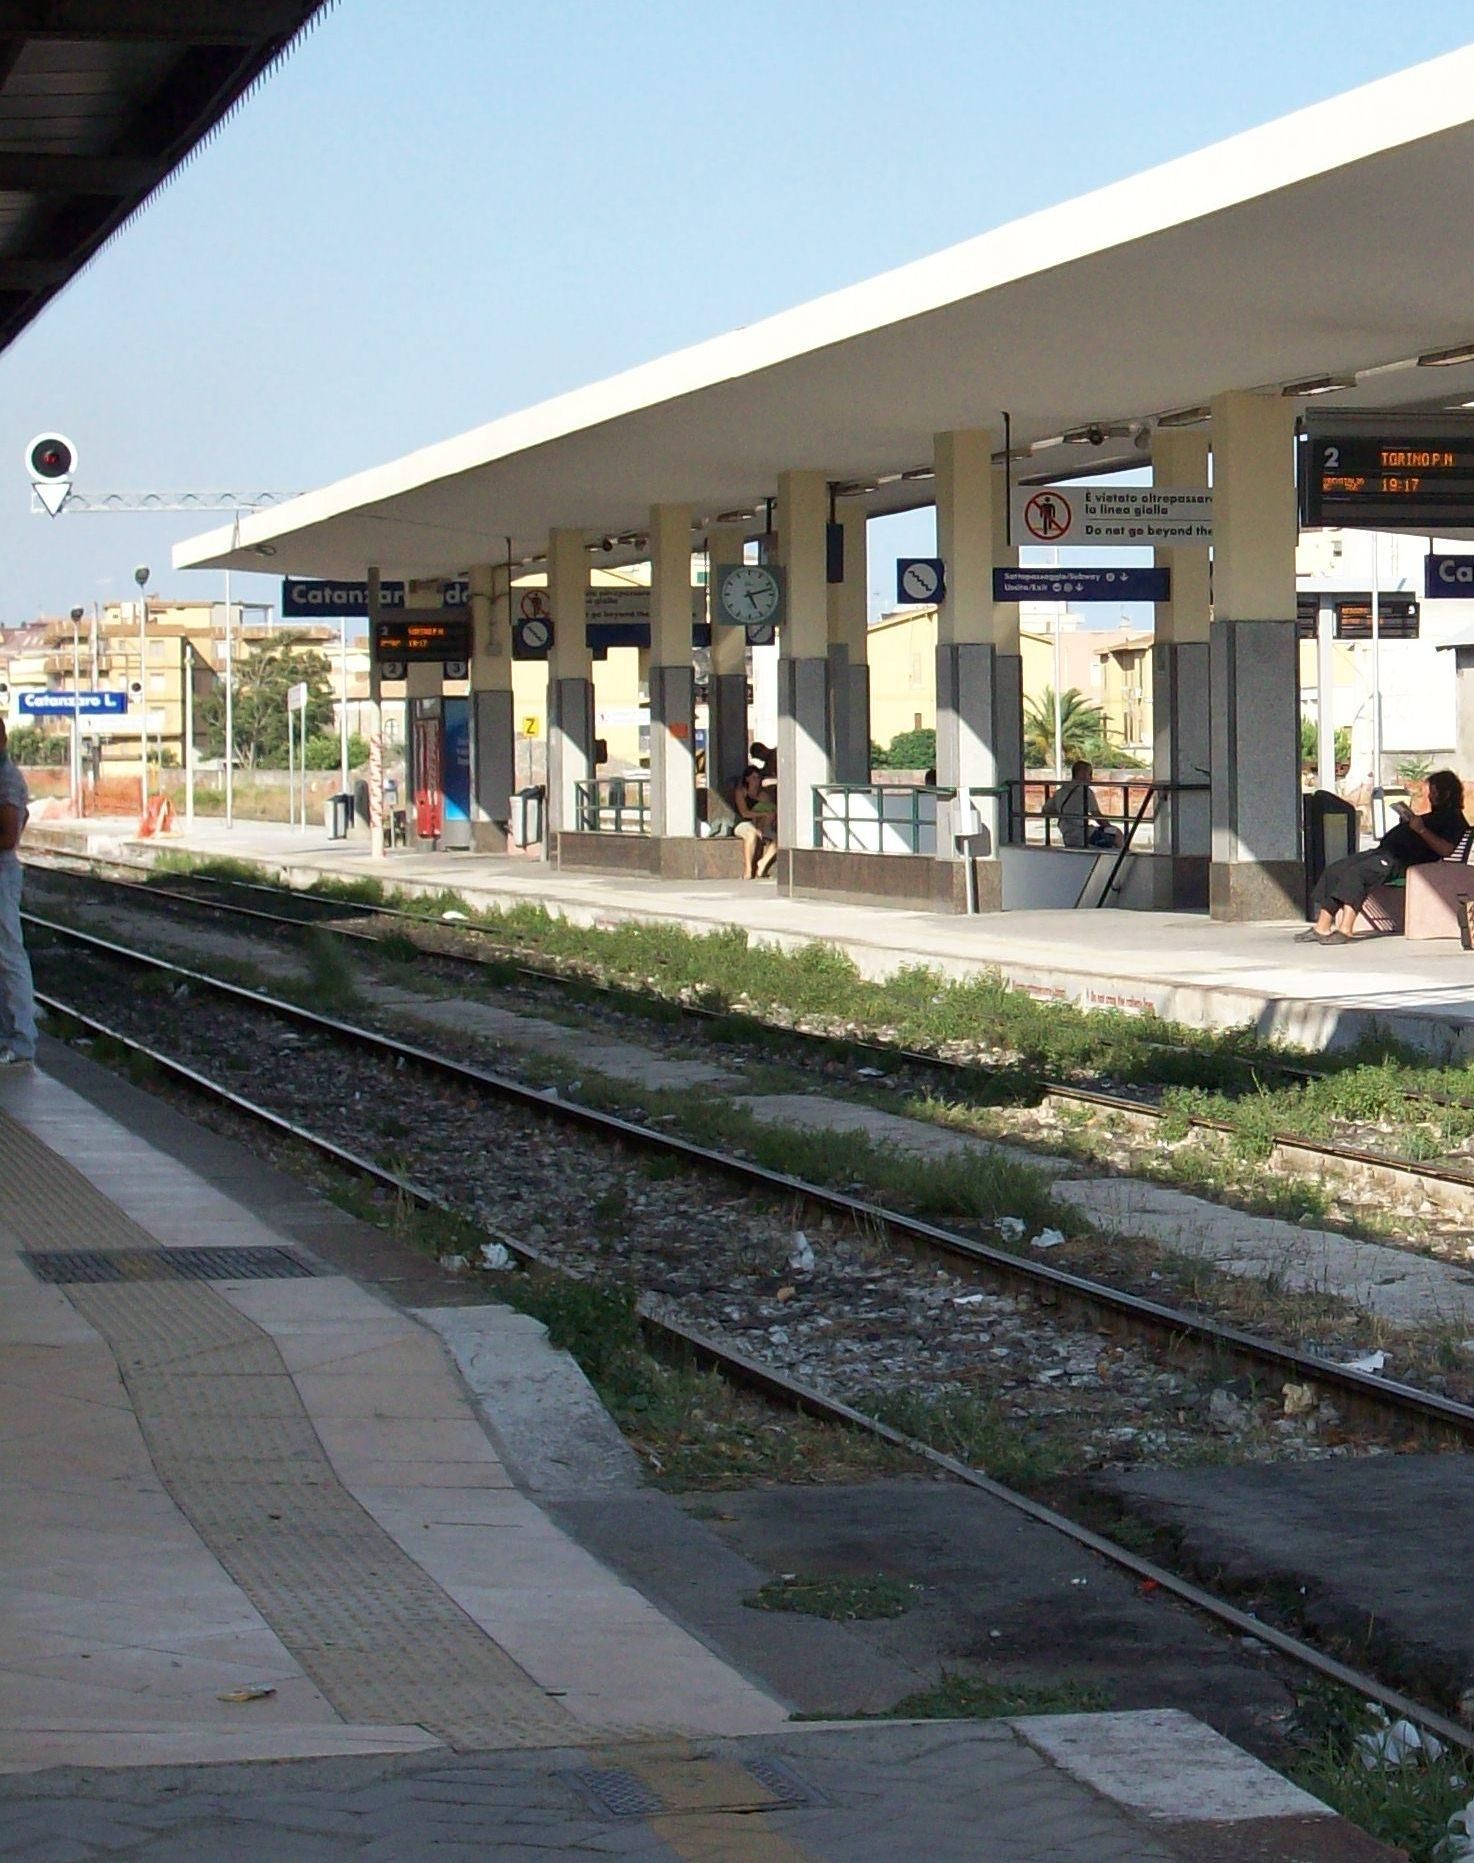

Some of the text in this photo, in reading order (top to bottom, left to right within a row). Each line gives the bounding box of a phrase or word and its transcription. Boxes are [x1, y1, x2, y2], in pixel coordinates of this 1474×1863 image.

[1324, 447, 1339, 467] 2
[1095, 493, 1138, 503] vietato
[1085, 504, 1168, 517] la linea gialla
[1085, 525, 1102, 535] Do
[1105, 526, 1125, 535] not
[1128, 528, 1144, 538] go
[1147, 525, 1193, 538] beyond
[388, 663, 397, 674] 2
[525, 718, 536, 734] Z
